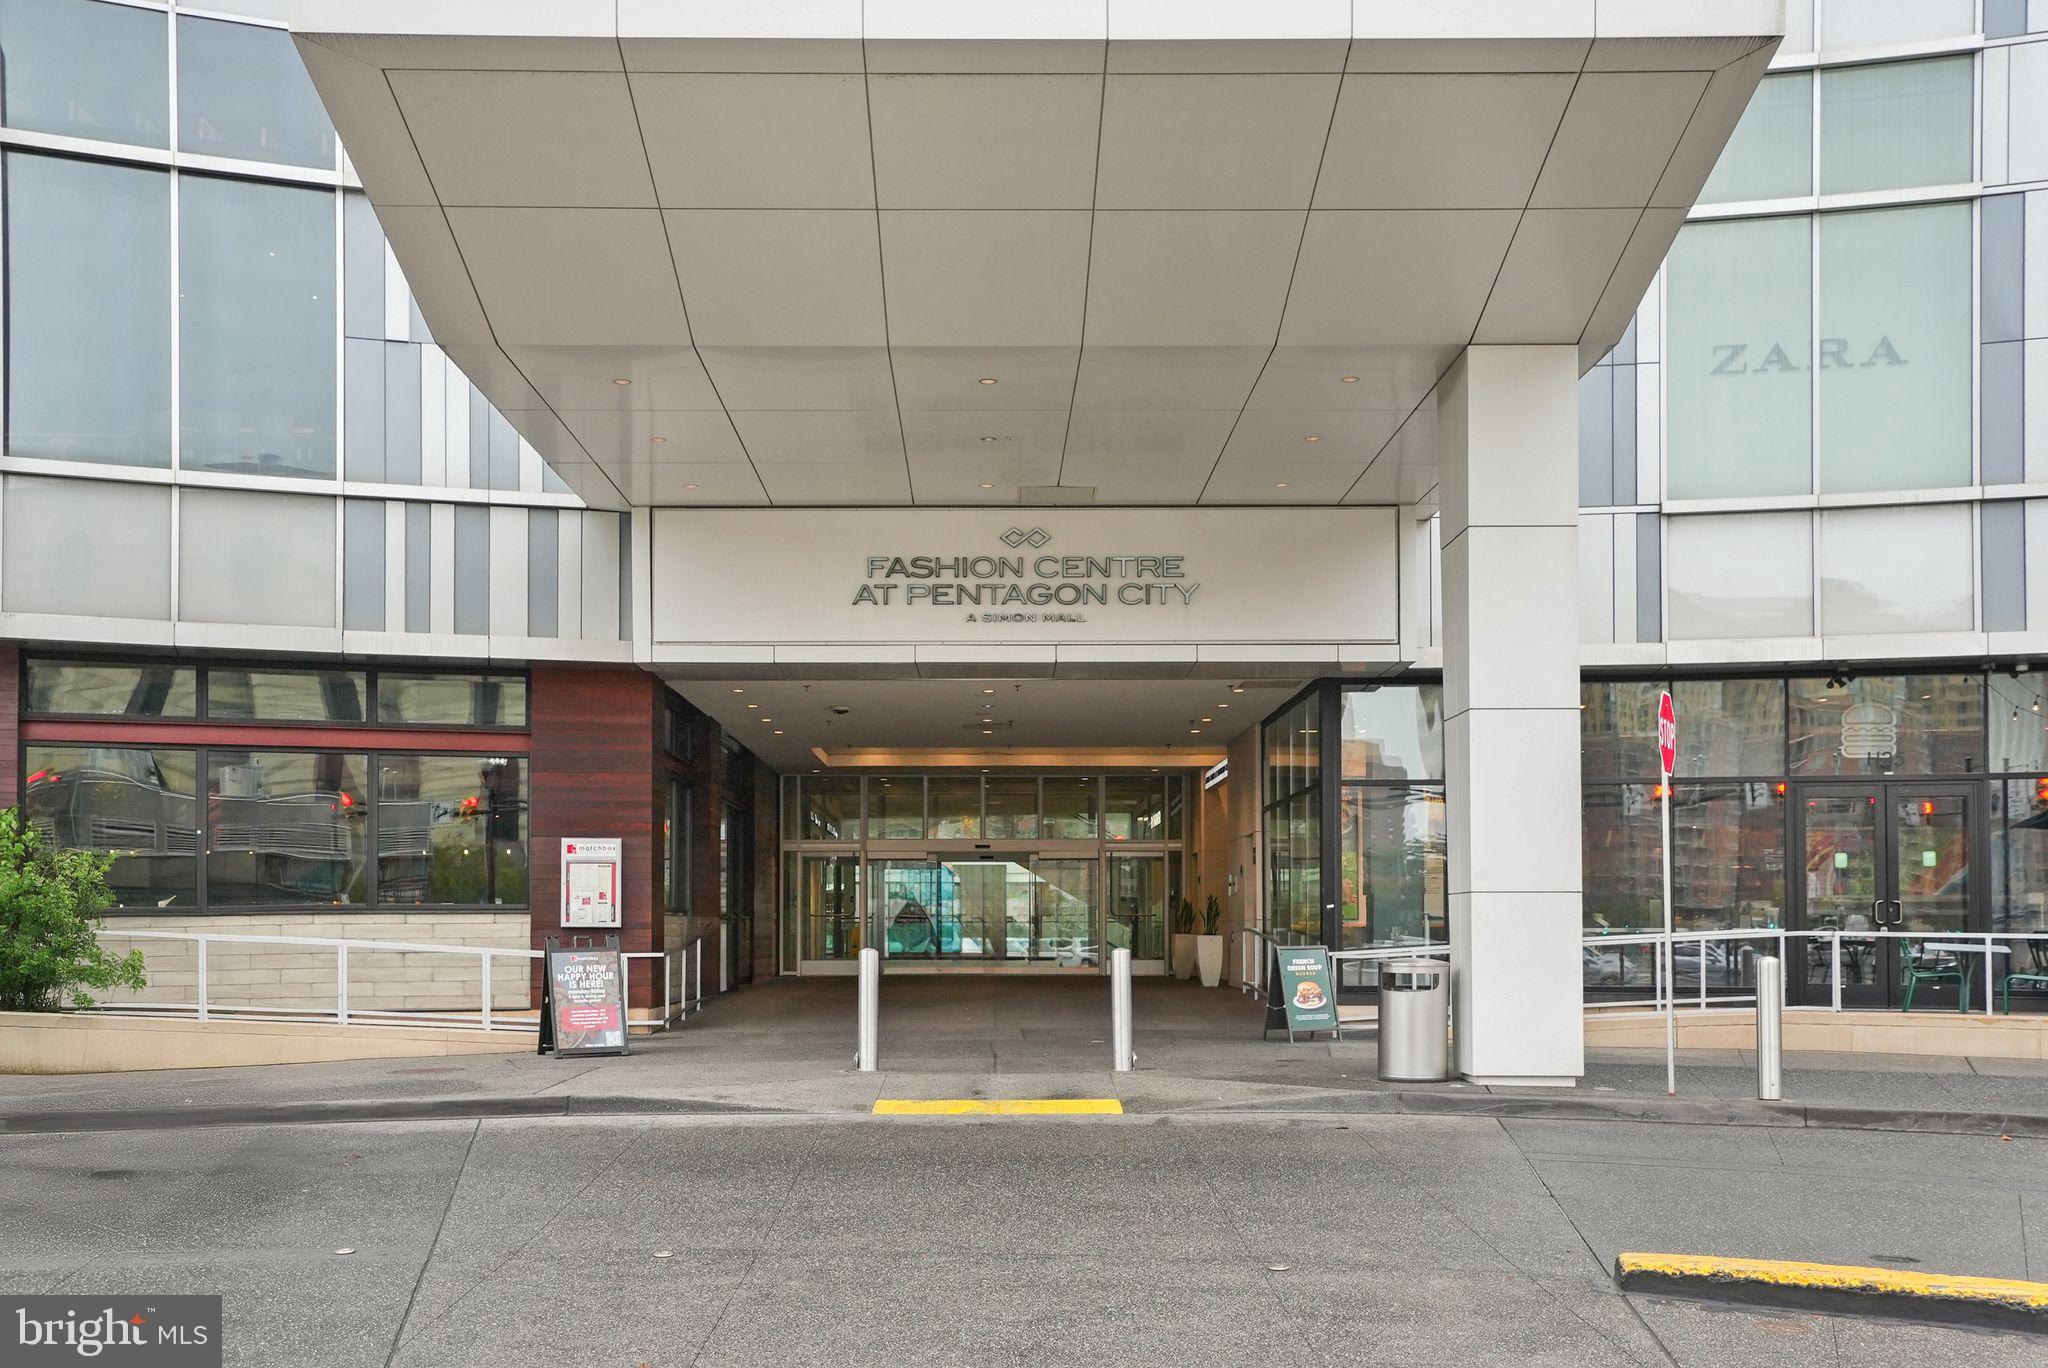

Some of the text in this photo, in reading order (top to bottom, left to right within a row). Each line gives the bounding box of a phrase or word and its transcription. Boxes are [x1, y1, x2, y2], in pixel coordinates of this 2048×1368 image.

[1710, 335, 1909, 375] ZARA
[866, 556, 1186, 578] FASHION CENTRE
[852, 583, 1200, 606] AT PENTAGON CITY
[965, 613, 1086, 623] A SIMON MALL
[1659, 717, 1675, 750] STOP
[557, 972, 614, 981] HAPPY HOUR
[564, 964, 607, 973] OUR NEW
[569, 980, 604, 989] IS HERE!
